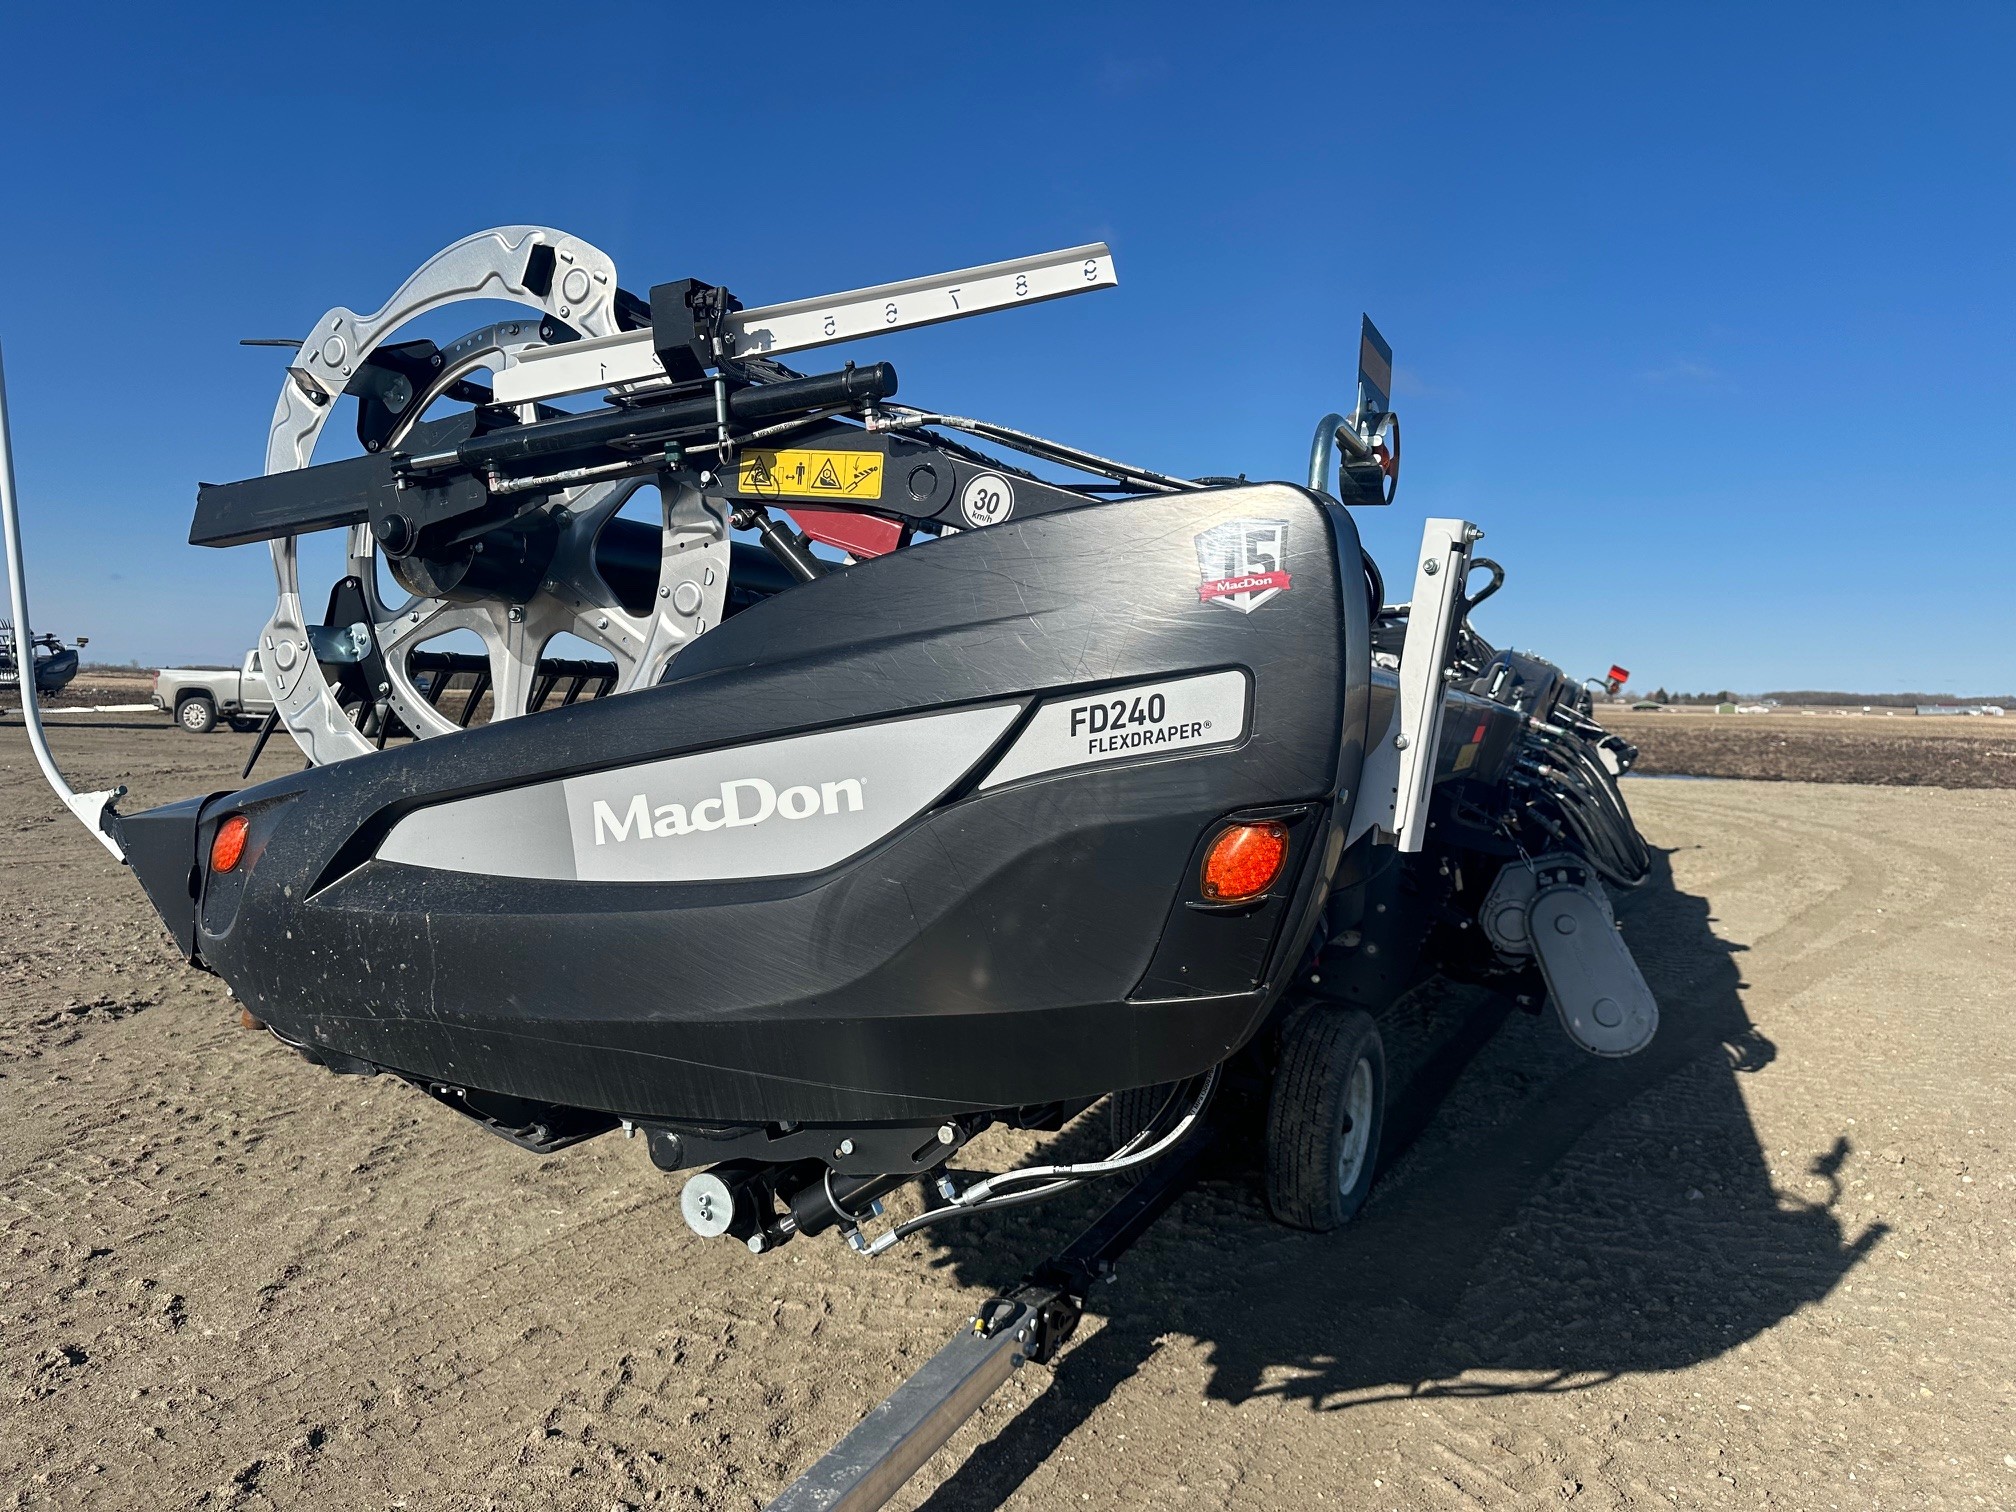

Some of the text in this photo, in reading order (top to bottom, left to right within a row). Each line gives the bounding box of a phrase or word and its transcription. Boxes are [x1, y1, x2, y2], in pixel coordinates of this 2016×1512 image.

[973, 488, 1001, 515] 30
[971, 509, 993, 524] km/h
[1216, 577, 1273, 592] MacDon
[1070, 692, 1166, 738] FD240
